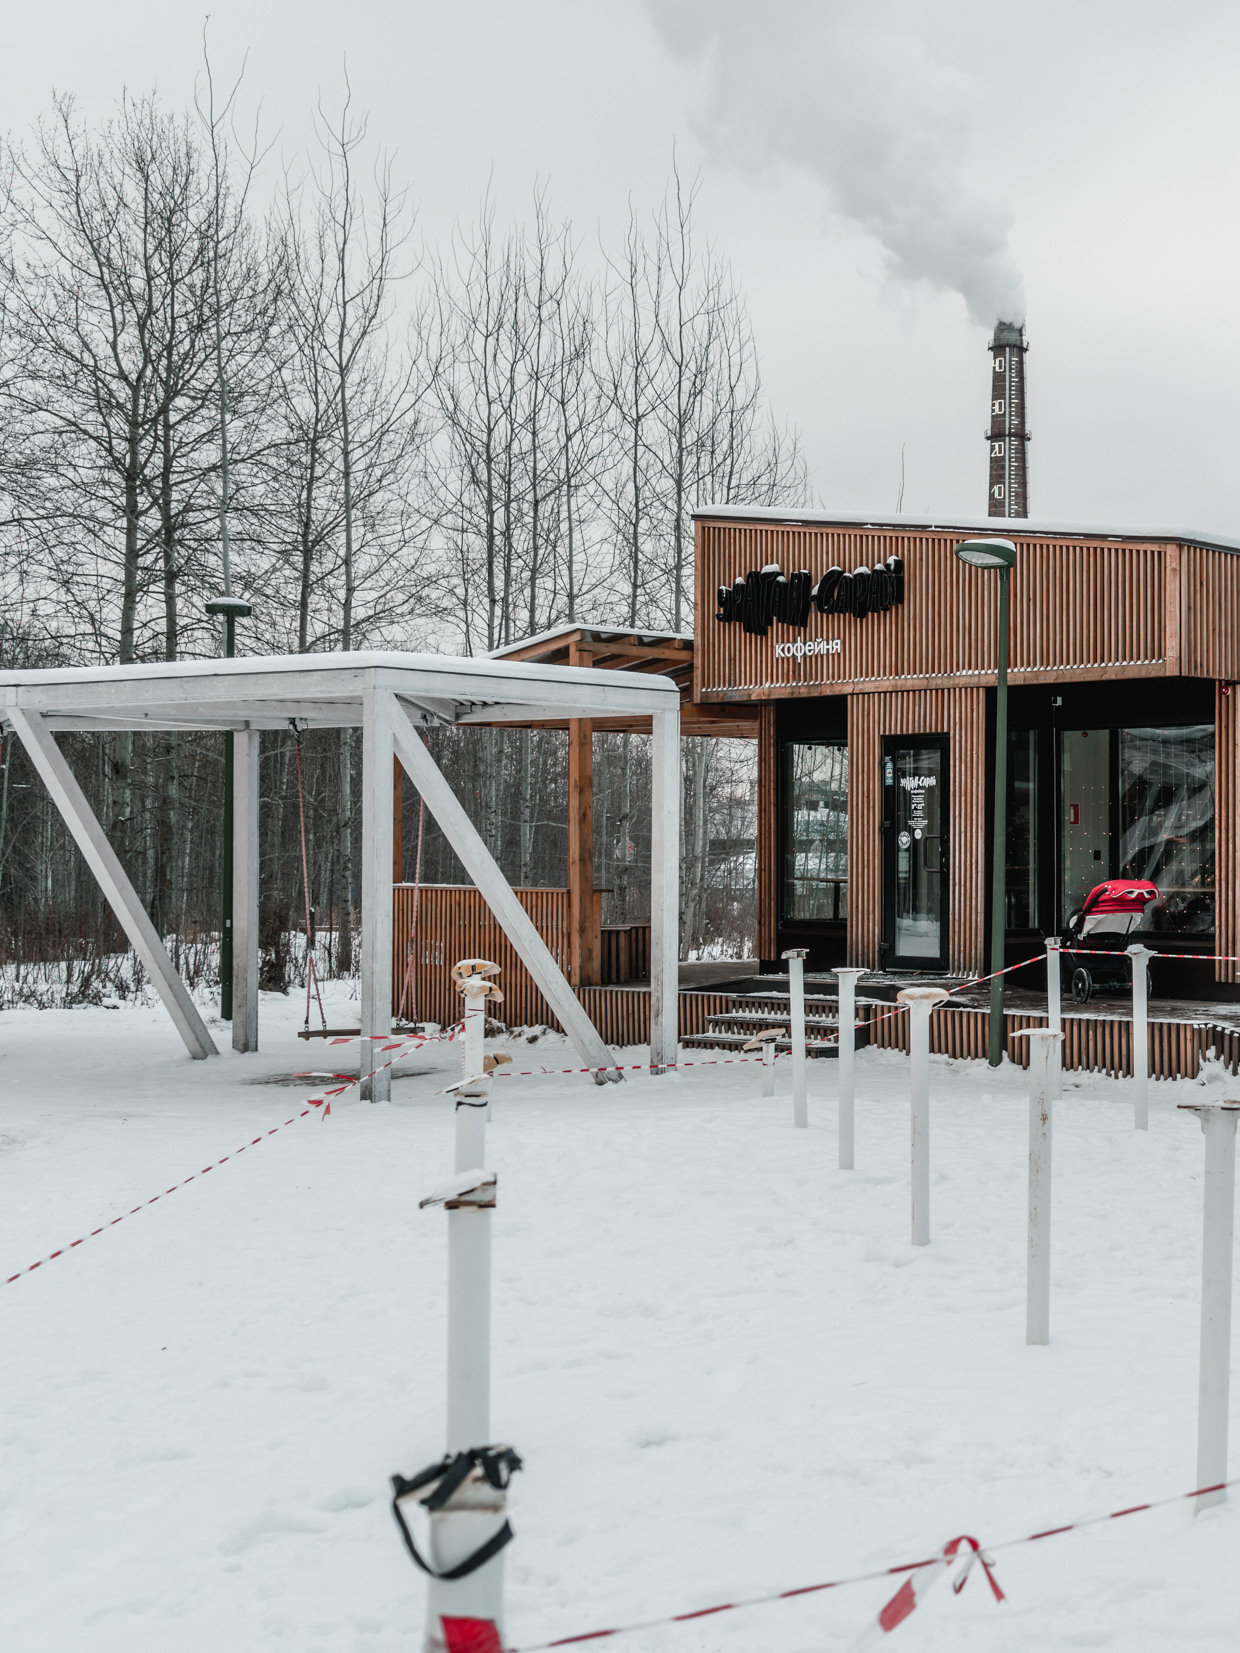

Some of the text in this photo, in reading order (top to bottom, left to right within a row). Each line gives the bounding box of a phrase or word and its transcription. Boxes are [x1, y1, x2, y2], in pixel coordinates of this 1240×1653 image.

[992, 357, 1004, 372] 40
[992, 399, 1004, 415] 30
[991, 441, 1004, 457] 20
[991, 484, 1004, 499] 10
[775, 636, 841, 663] кофейня
